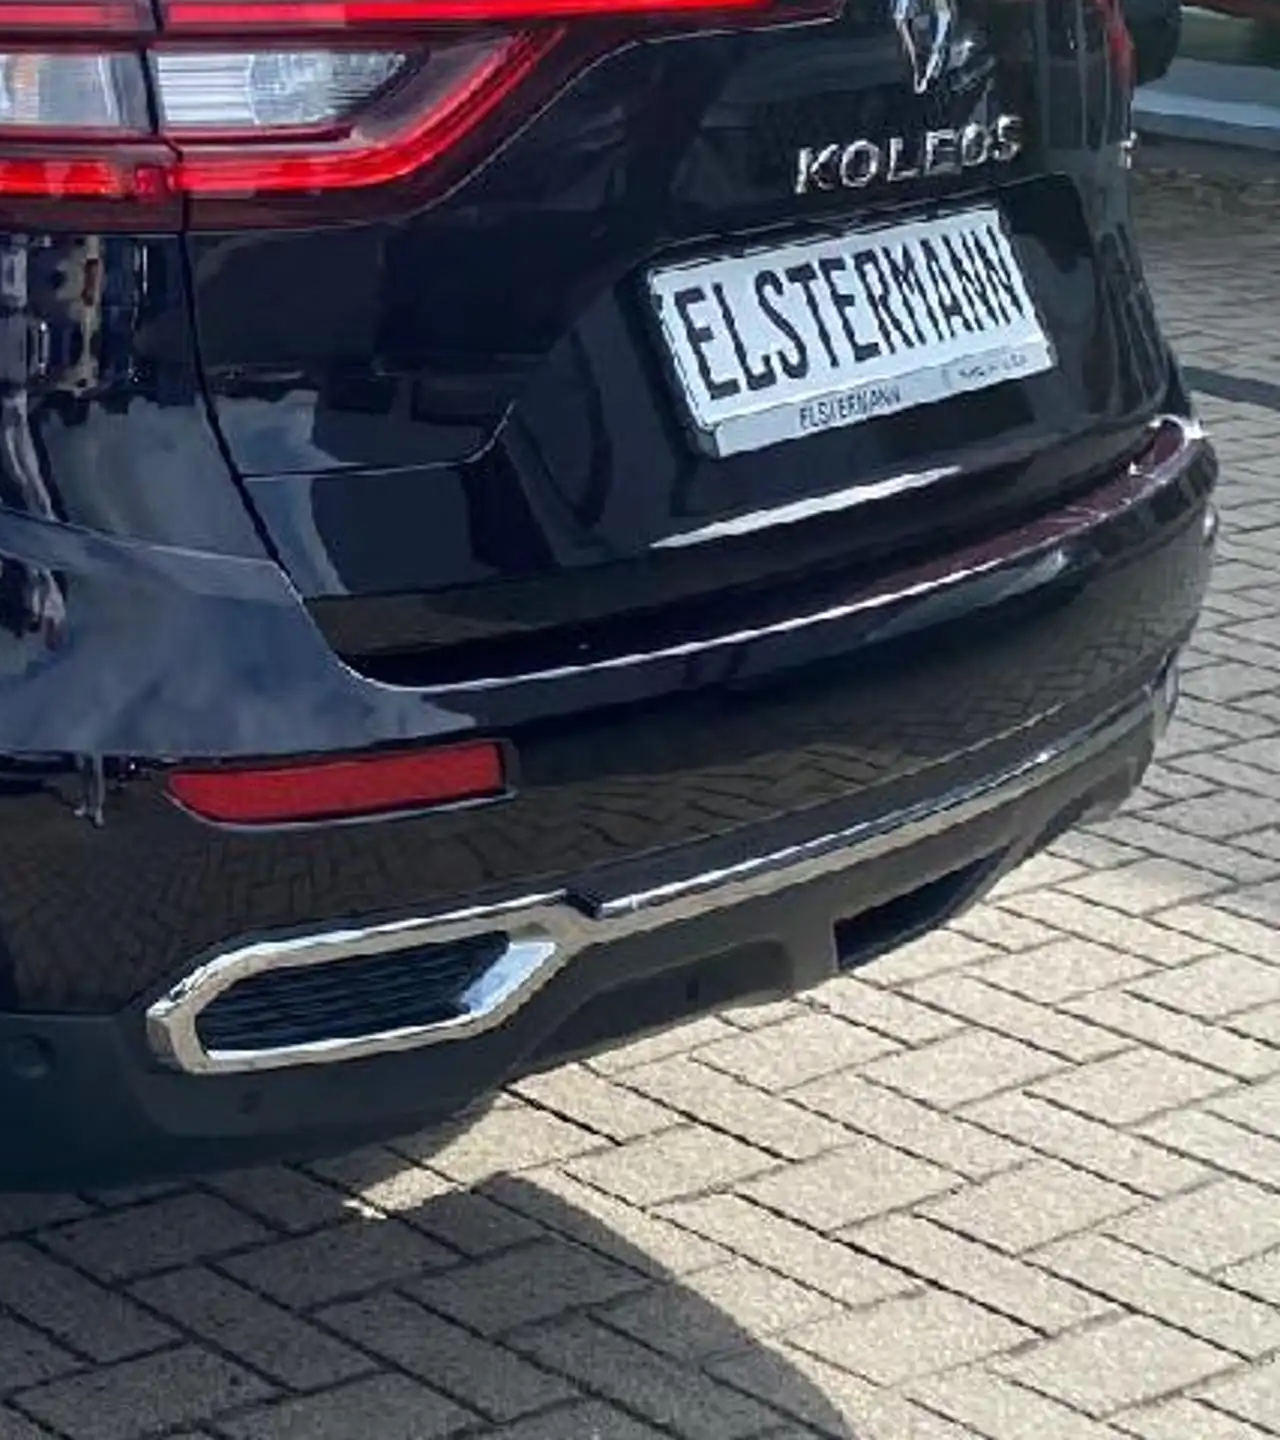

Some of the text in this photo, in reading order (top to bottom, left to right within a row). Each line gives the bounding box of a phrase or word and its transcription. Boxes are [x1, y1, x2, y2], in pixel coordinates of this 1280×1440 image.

[797, 115, 1021, 193] KOLEOS
[675, 226, 1024, 400] ELSTERMANN
[800, 386, 901, 429] ELSTERMANN
